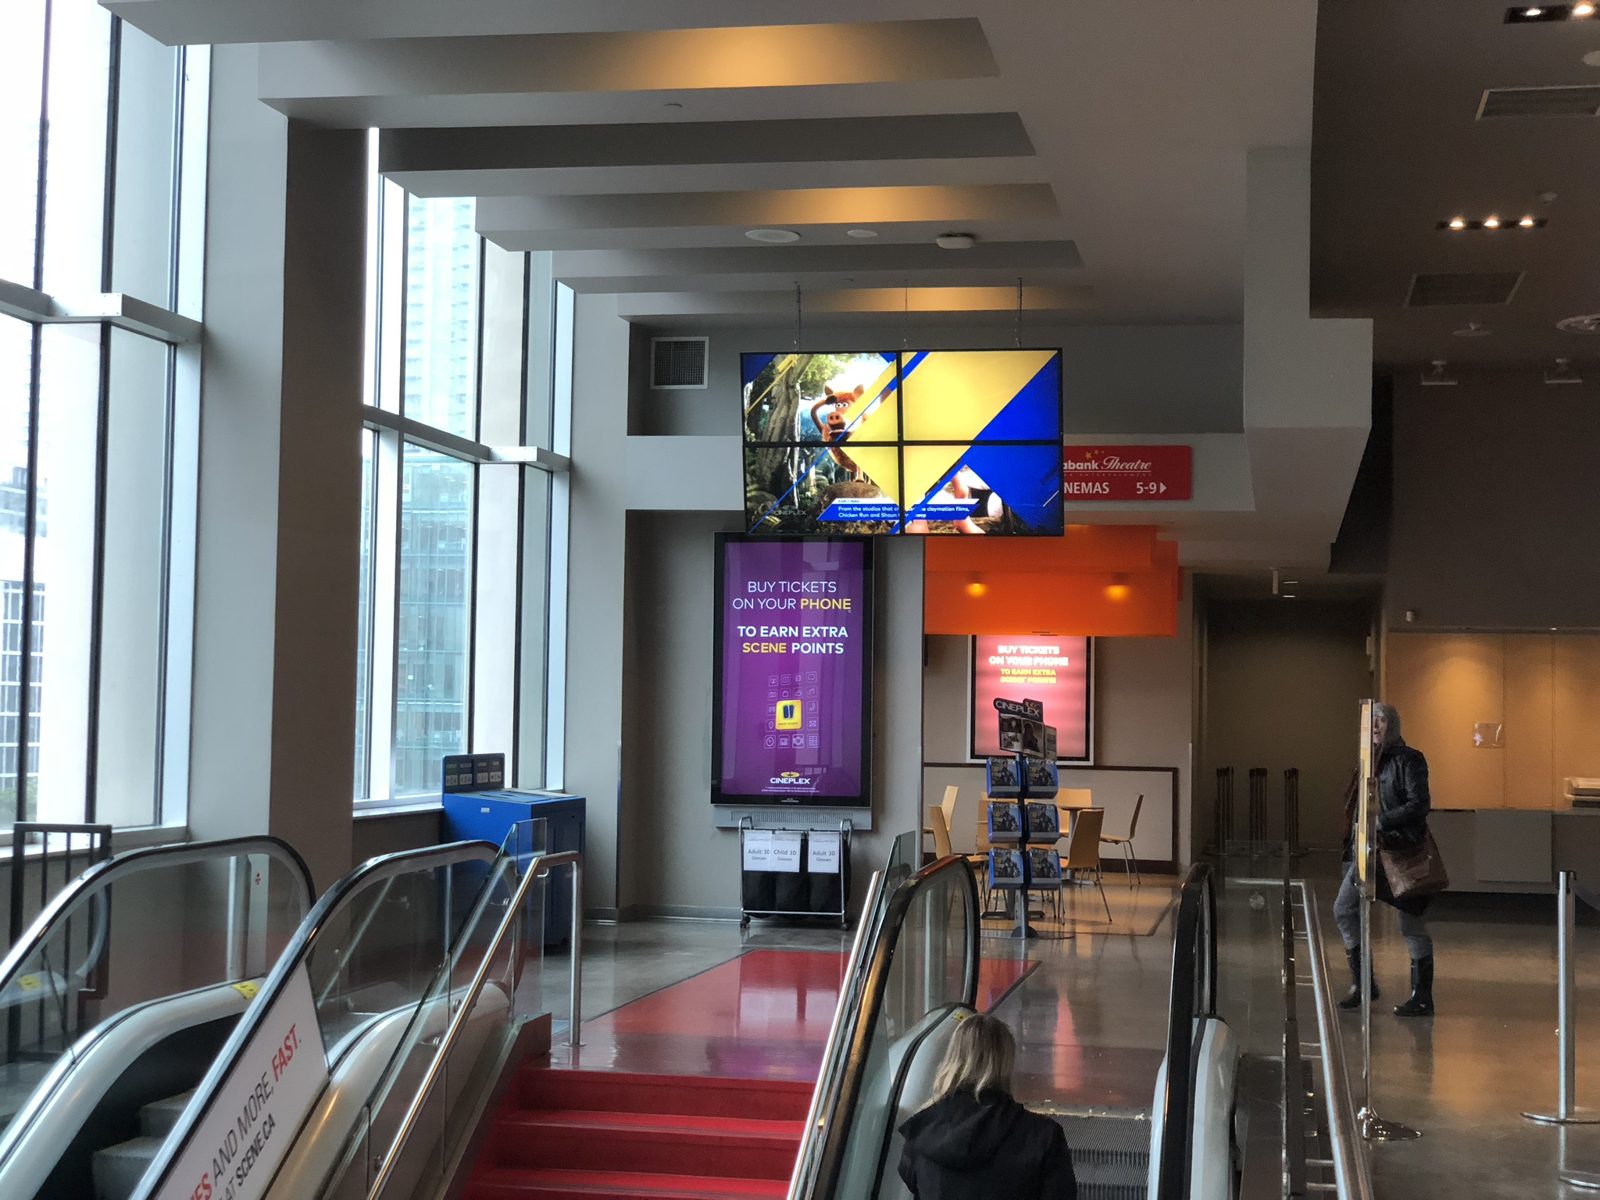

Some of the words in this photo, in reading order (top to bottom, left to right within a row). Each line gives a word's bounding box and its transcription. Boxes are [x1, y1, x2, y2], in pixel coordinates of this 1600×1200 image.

[1100, 456, 1152, 470] Theatre
[1136, 482, 1157, 494] 5-9
[747, 581, 776, 593] BUY
[778, 581, 837, 593] TICKETS
[732, 598, 754, 610] ON
[757, 598, 797, 610] YOUR
[800, 598, 851, 610] PHONE
[737, 626, 757, 637] TO
[760, 626, 799, 638] EARN
[802, 626, 848, 638] EXTRA
[742, 642, 787, 653] SCENE
[791, 642, 844, 654] POINTS
[997, 645, 1018, 655] BUY
[1019, 645, 1060, 655] TICKETS
[988, 655, 1005, 666] ON
[1005, 656, 1032, 666] YOUR
[1033, 656, 1069, 667] PHONE
[1000, 668, 1011, 676] TO
[1011, 668, 1032, 676] EARN
[1032, 668, 1057, 676] EXTRA
[995, 700, 1040, 717] CINEPLEX
[769, 777, 811, 785] CINEPLEX
[212, 1129, 238, 1187] AND
[237, 1071, 274, 1141] MORE,
[271, 1023, 302, 1082] FAST.
[235, 1113, 276, 1187] SCENE.CA
